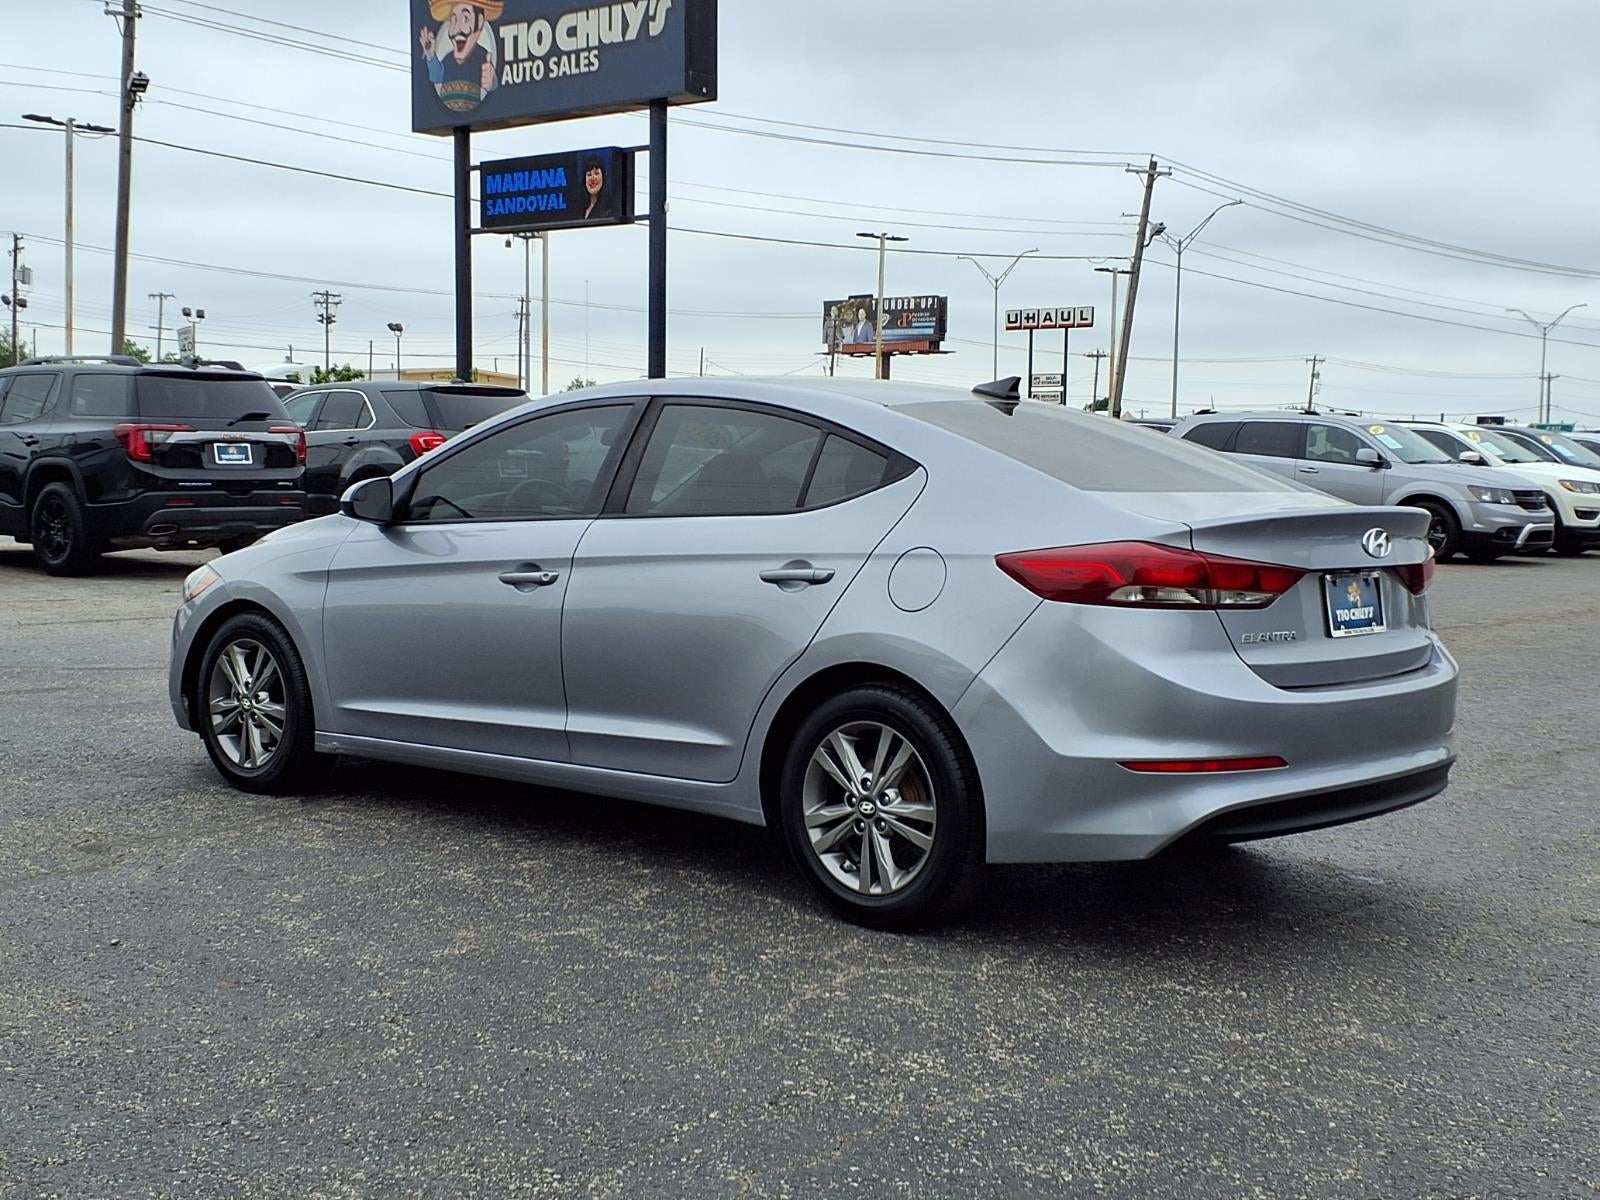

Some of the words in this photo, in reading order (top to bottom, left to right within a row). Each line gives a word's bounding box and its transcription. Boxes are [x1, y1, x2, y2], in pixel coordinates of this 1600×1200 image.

[499, 19, 553, 62] TIO
[555, 0, 672, 51] CHUY'S
[501, 61, 545, 86] AUTO
[549, 50, 599, 79] SALES
[486, 167, 567, 194] MARIANA
[486, 193, 567, 216] SANDOVAL
[872, 298, 915, 311] TUNDER
[920, 297, 938, 309] UP!
[1336, 609, 1350, 622] TIO
[1241, 630, 1297, 643] ELANTRA
